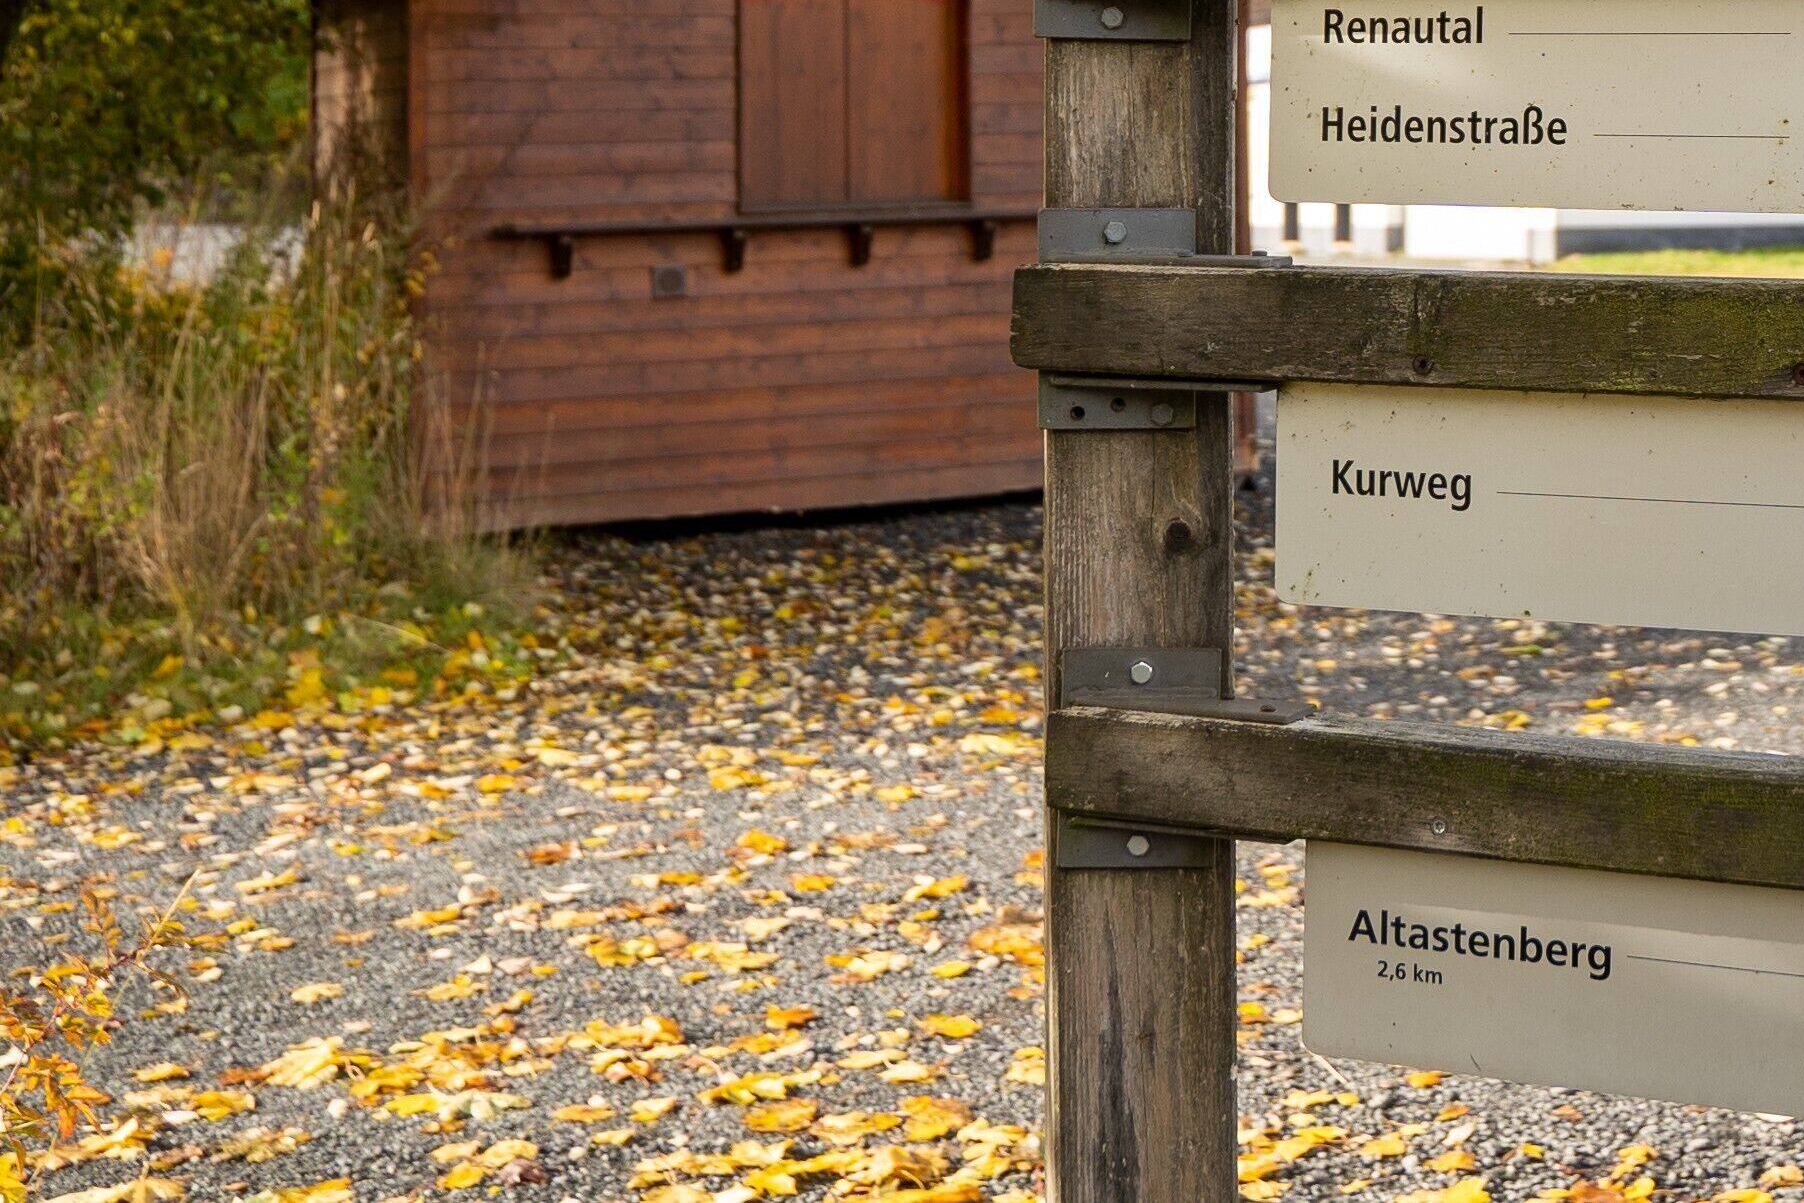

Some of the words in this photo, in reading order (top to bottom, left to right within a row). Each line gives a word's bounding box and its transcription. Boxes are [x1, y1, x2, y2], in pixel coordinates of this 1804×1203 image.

[1323, 5, 1484, 44] Renautal
[1321, 103, 1568, 146] Heidenstraße
[1332, 459, 1472, 512] Kurweg
[1347, 909, 1612, 980] Altastenberg
[1377, 960, 1407, 982] 2,6
[1413, 963, 1443, 985] km
